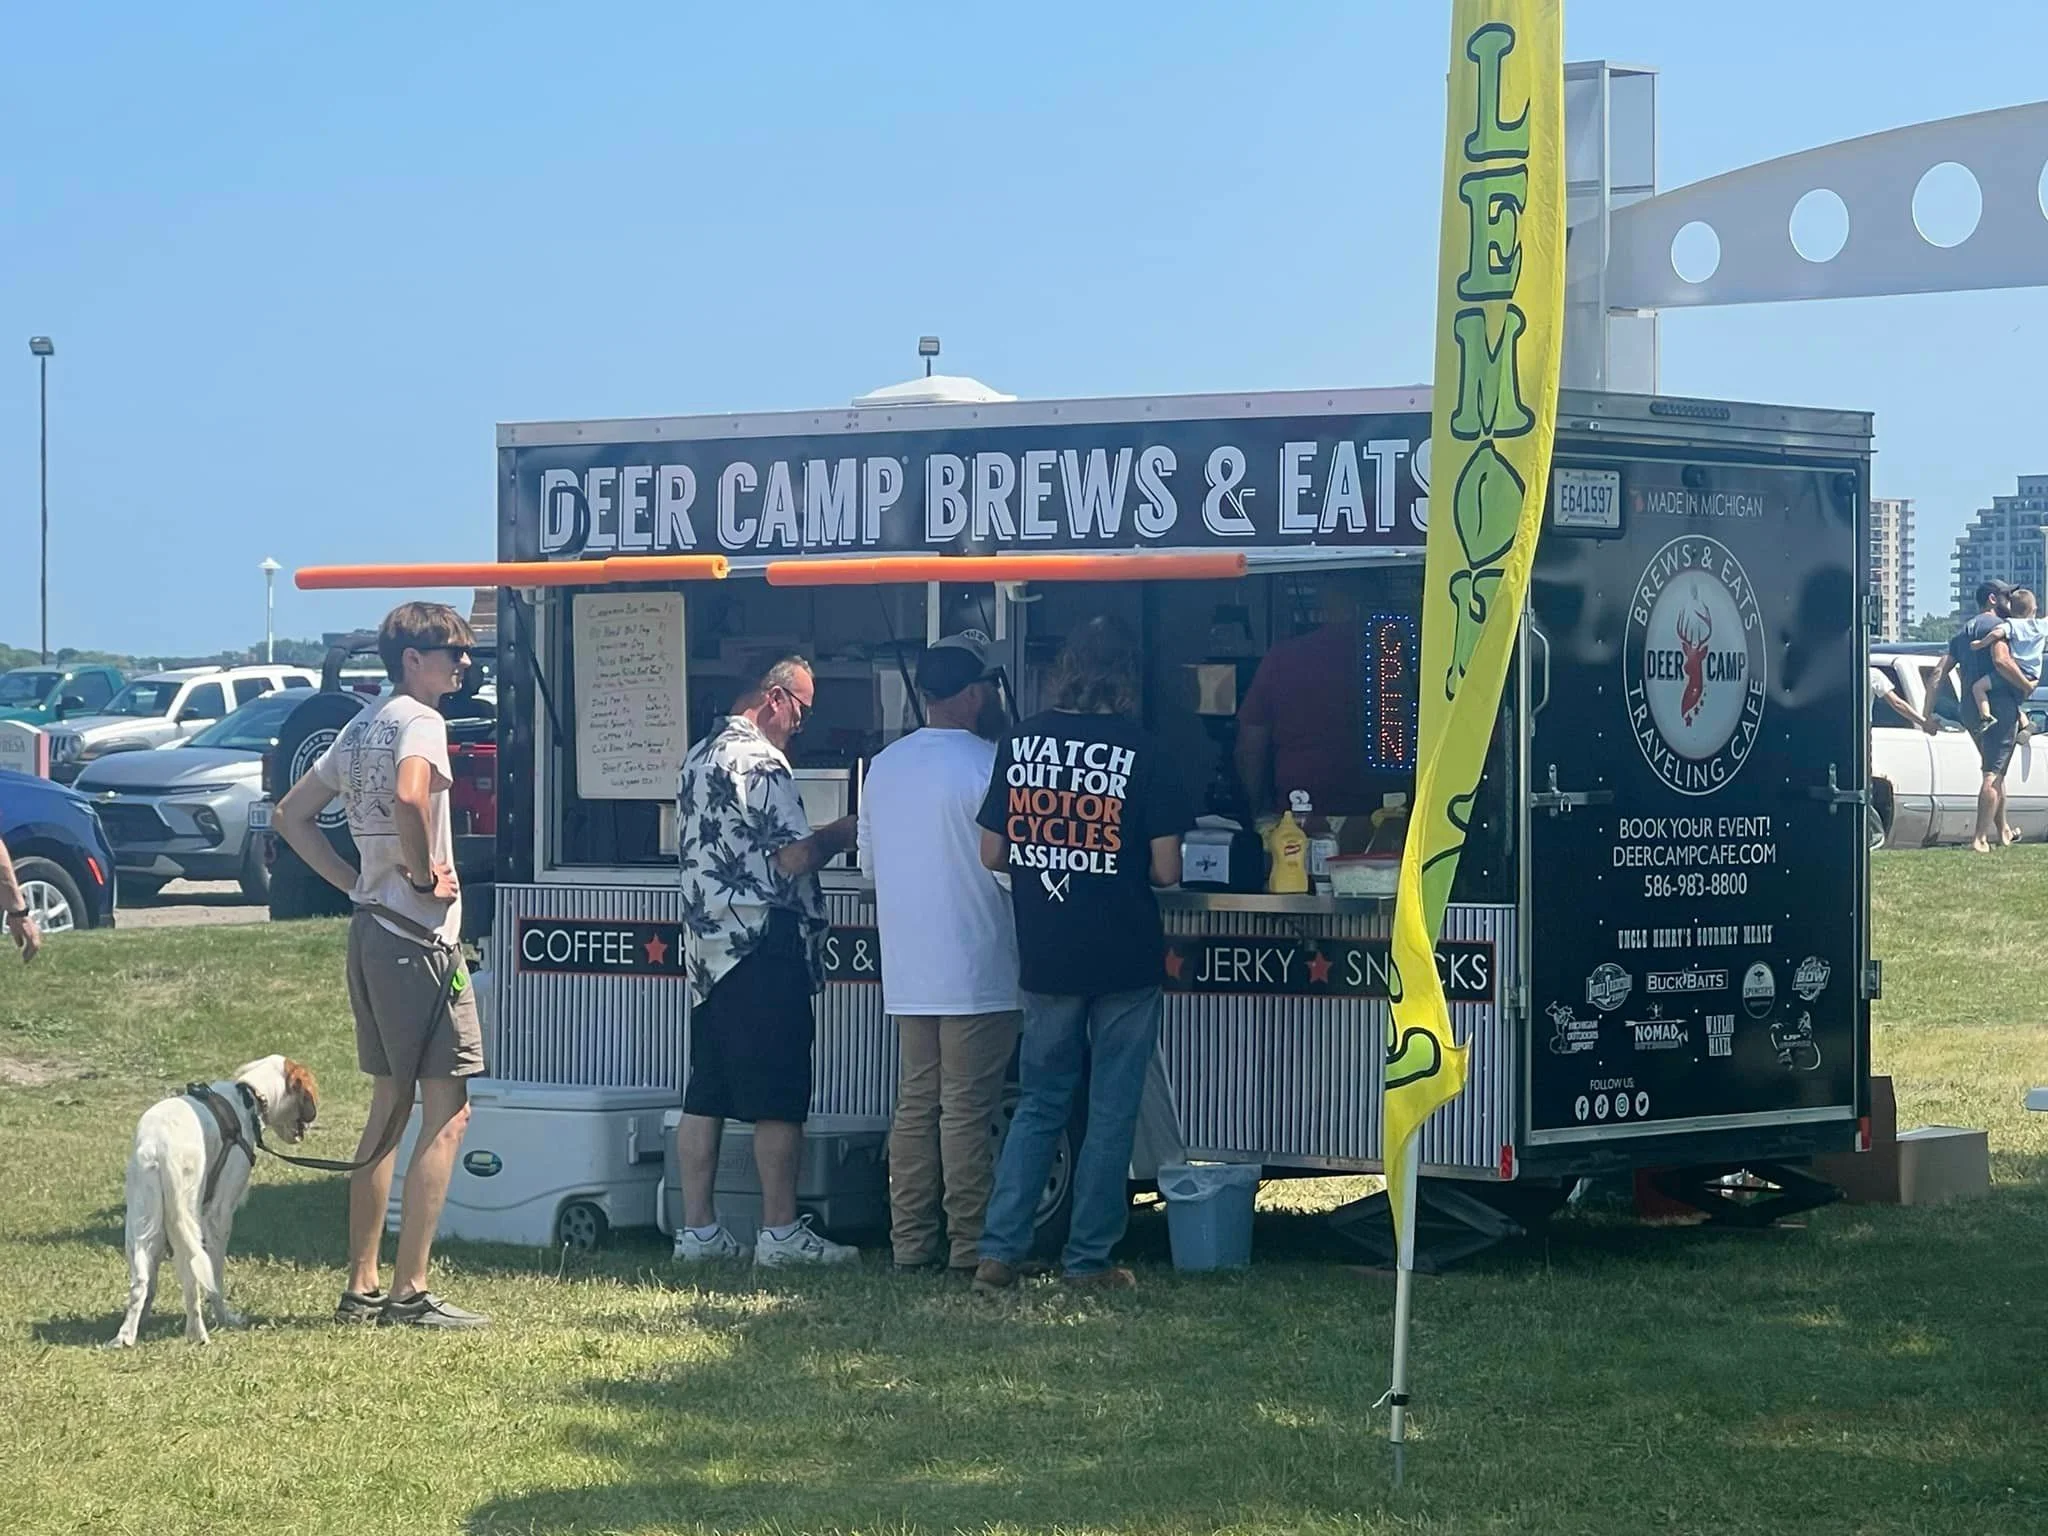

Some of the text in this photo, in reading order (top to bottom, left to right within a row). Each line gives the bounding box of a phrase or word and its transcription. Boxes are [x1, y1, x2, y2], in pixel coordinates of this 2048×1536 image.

[540, 463, 697, 553] DEER
[716, 456, 902, 549] CAMP
[924, 445, 1178, 543] BREWS
[1202, 446, 1256, 536] &
[1560, 484, 1613, 514] E641597
[1647, 491, 1763, 517] MADE IN MICHIGAN
[1634, 543, 1759, 631] BREWS & EATS
[1647, 650, 1746, 681] DEER CAMP
[1628, 679, 1763, 787] TRAVELING CAFE
[1012, 735, 1136, 776] WATCH
[1006, 763, 1128, 799] OUT FOR
[1008, 787, 1123, 825] MOTOR
[1007, 815, 1122, 853] CYCLES
[1619, 816, 1770, 839] BOOK YOUR EVENT!
[1009, 843, 1118, 874] ASSHOLE
[1613, 843, 1776, 867] DEERCAMPCAFE.COM
[1644, 872, 1747, 897] 586-983-8800
[522, 928, 633, 965] COFFEE
[852, 938, 874, 972] &
[1196, 947, 1295, 984] JERKY
[1346, 950, 1488, 991] SNKS
[1635, 1024, 1678, 1042] NOMAD
[1590, 1079, 1622, 1091] FOLLOW
